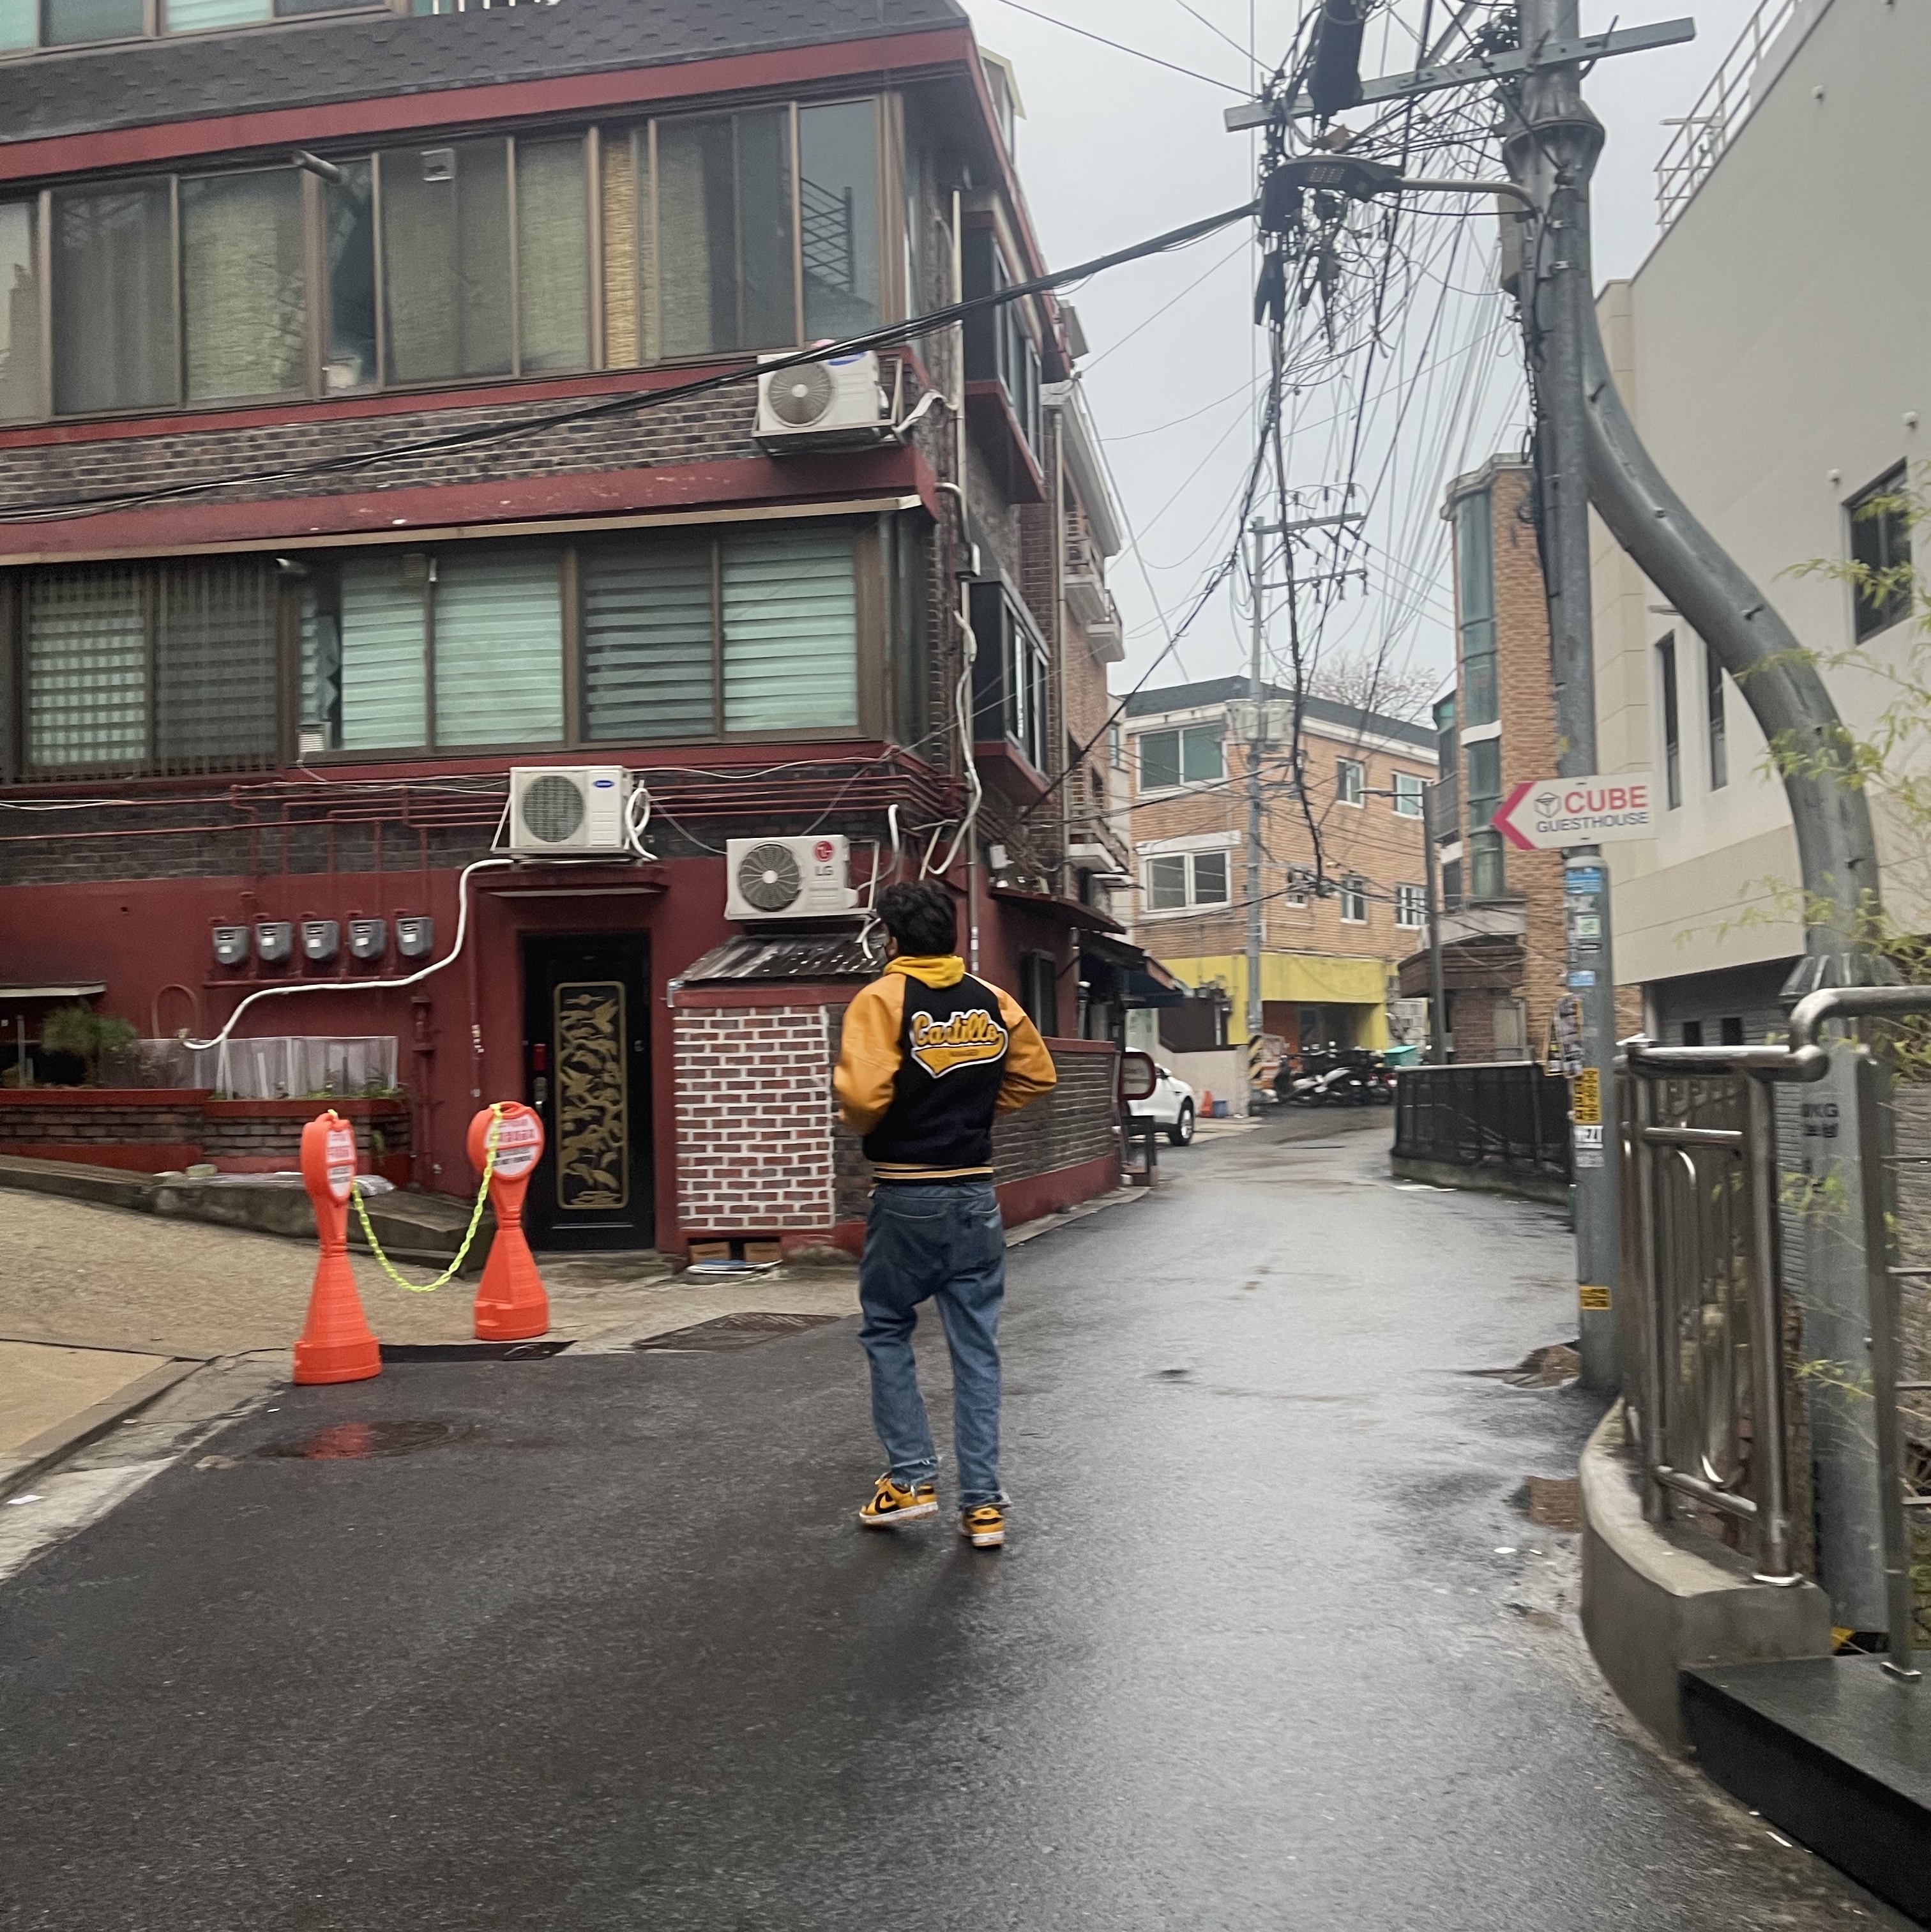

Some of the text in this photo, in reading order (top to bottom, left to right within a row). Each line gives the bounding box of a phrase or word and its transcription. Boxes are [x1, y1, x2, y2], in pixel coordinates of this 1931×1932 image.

[1564, 785, 1648, 814] CUBE
[1536, 811, 1649, 833] GUESTHOUSE
[814, 865, 834, 876] LG
